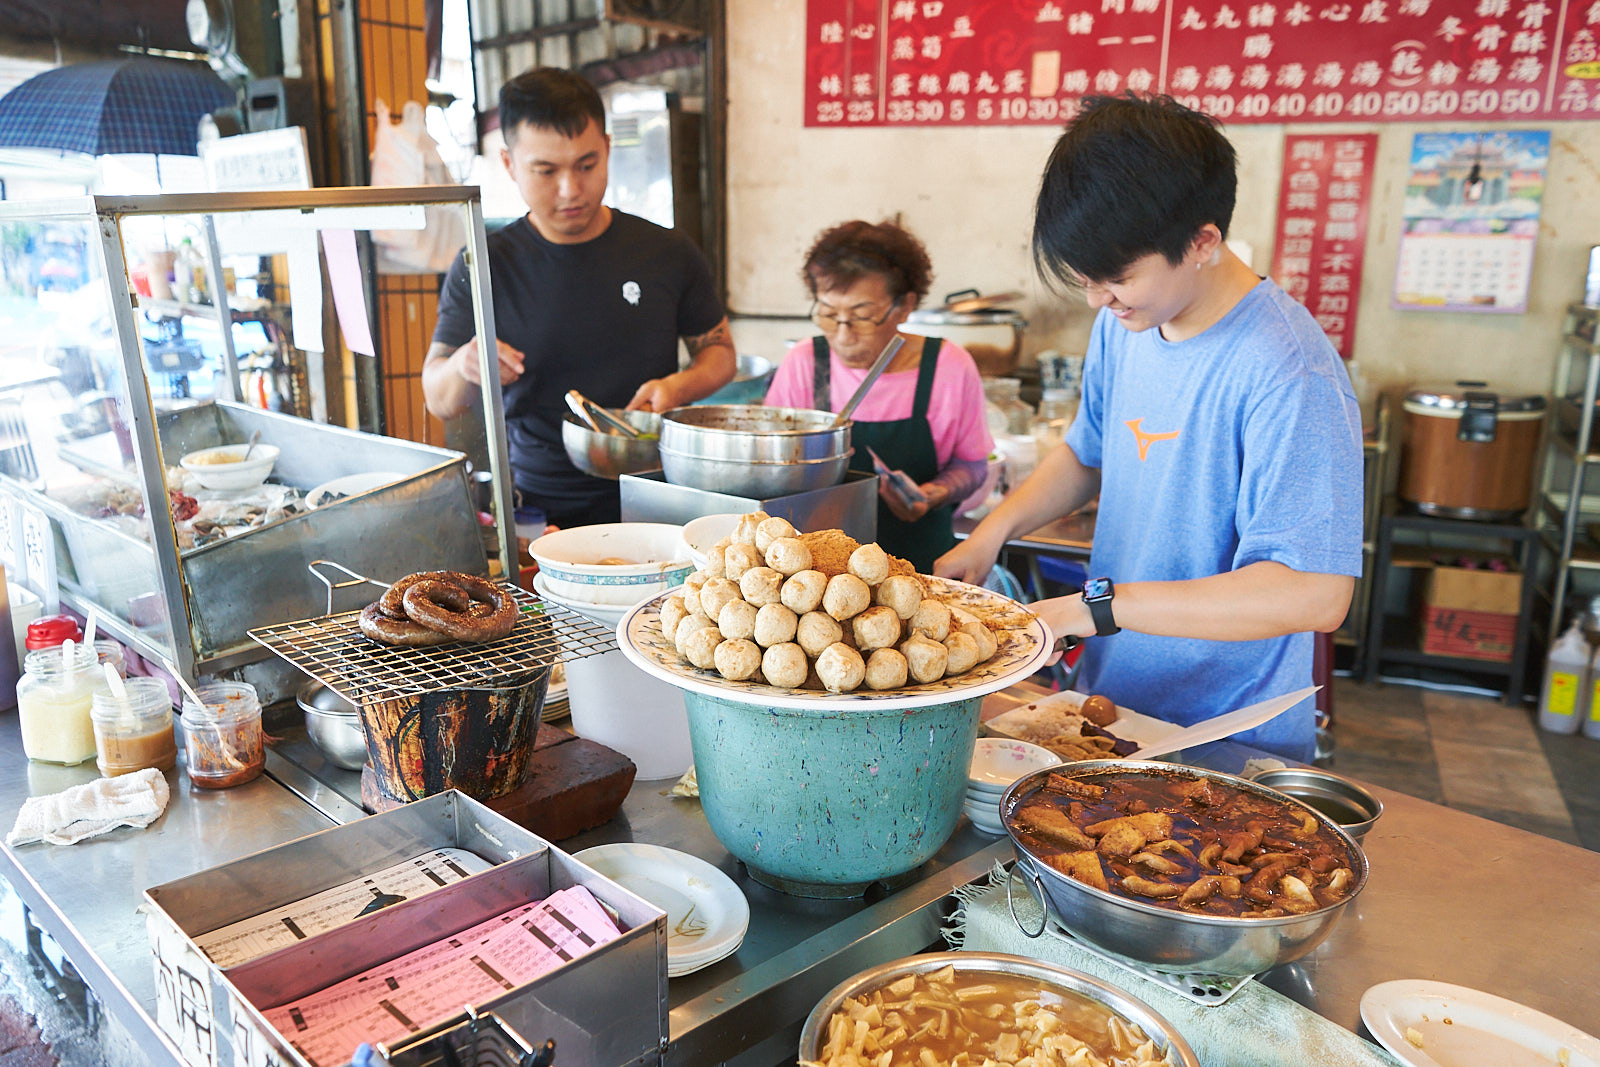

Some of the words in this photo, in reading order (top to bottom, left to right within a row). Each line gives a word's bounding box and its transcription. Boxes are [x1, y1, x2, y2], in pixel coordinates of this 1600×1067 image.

[817, 101, 844, 122] 25
[847, 100, 874, 122] 25
[887, 100, 915, 122] 35
[914, 99, 944, 122] 30
[949, 99, 966, 121] 5
[977, 98, 993, 121] 5
[999, 97, 1028, 120] 10
[1028, 97, 1059, 120] 30
[1201, 94, 1235, 118] 30
[1236, 93, 1271, 117] 40
[1271, 92, 1306, 117] 40
[1307, 91, 1344, 116] 40
[1345, 91, 1382, 115] 40
[1382, 90, 1421, 115] 50
[1420, 89, 1459, 115] 50
[1460, 89, 1500, 114] 50
[1499, 88, 1541, 113] 50
